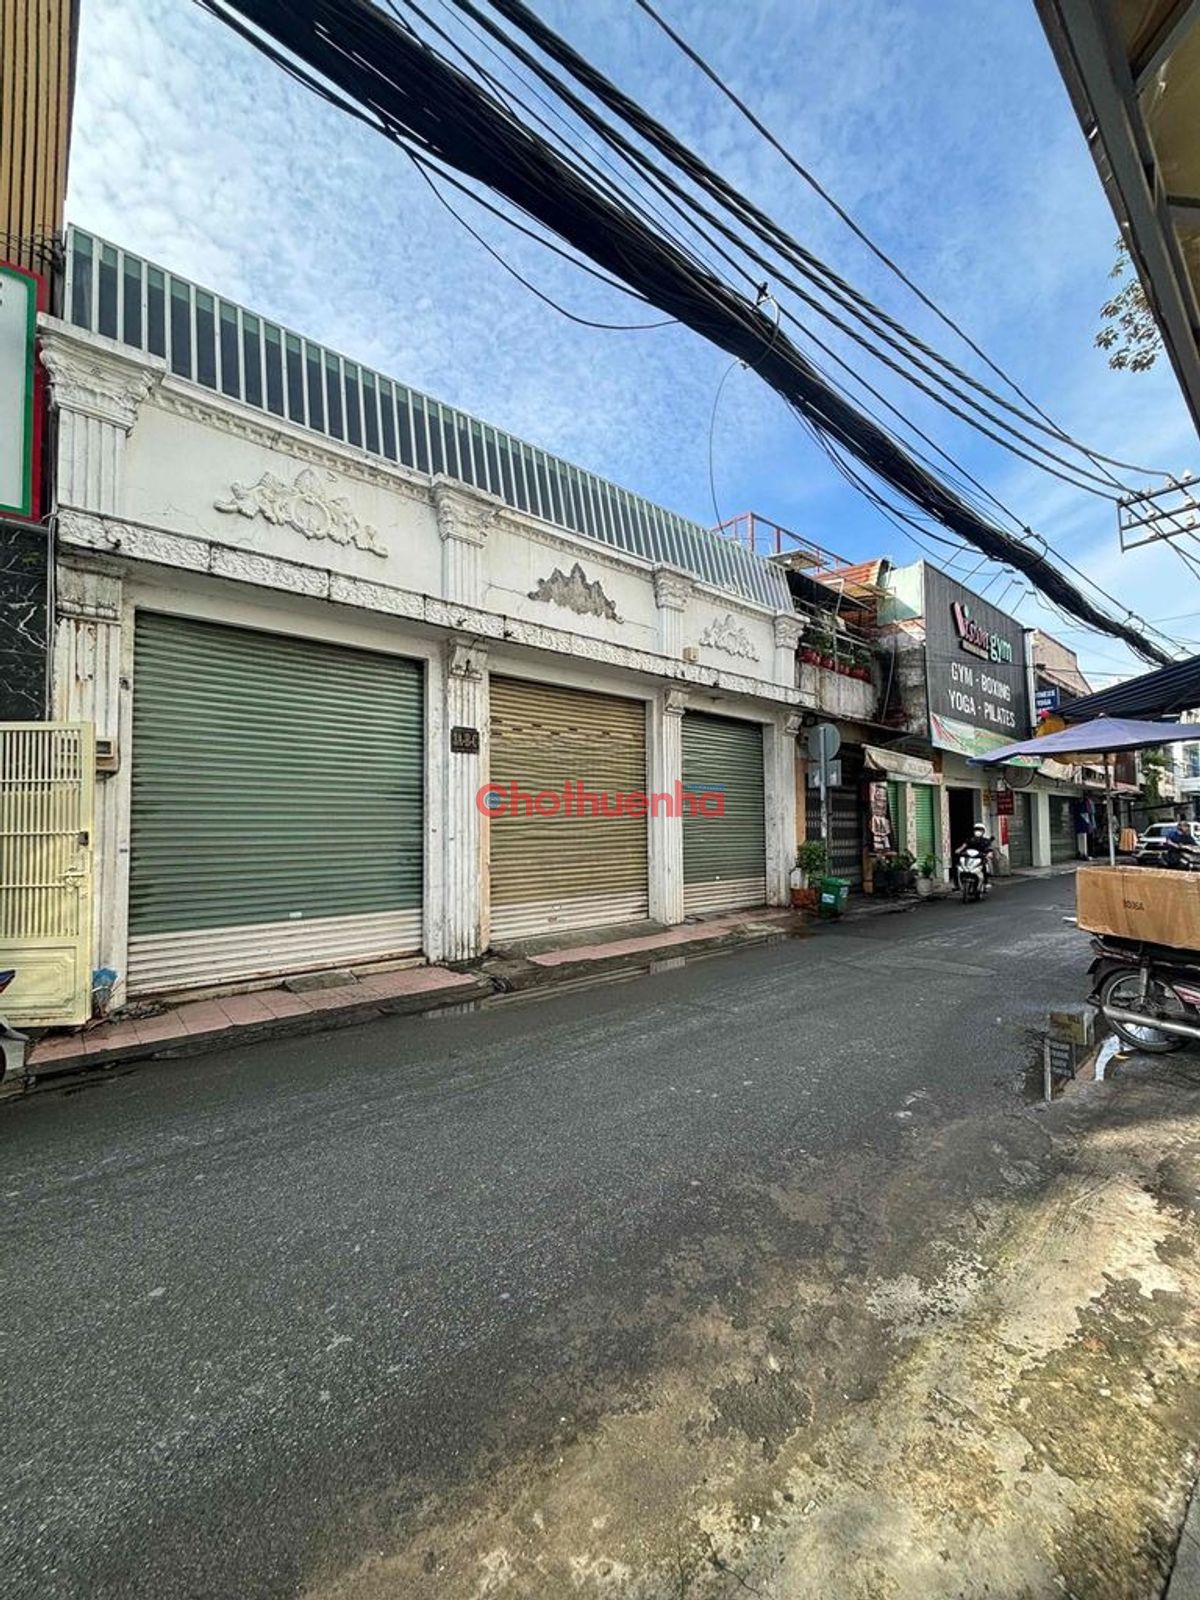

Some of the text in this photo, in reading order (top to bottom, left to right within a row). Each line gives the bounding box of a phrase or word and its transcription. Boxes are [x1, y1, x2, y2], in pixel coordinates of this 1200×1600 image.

[990, 633, 1012, 663] gym
[951, 662, 1011, 702] GYM BOXING
[948, 689, 1015, 728] YOGA PILATES
